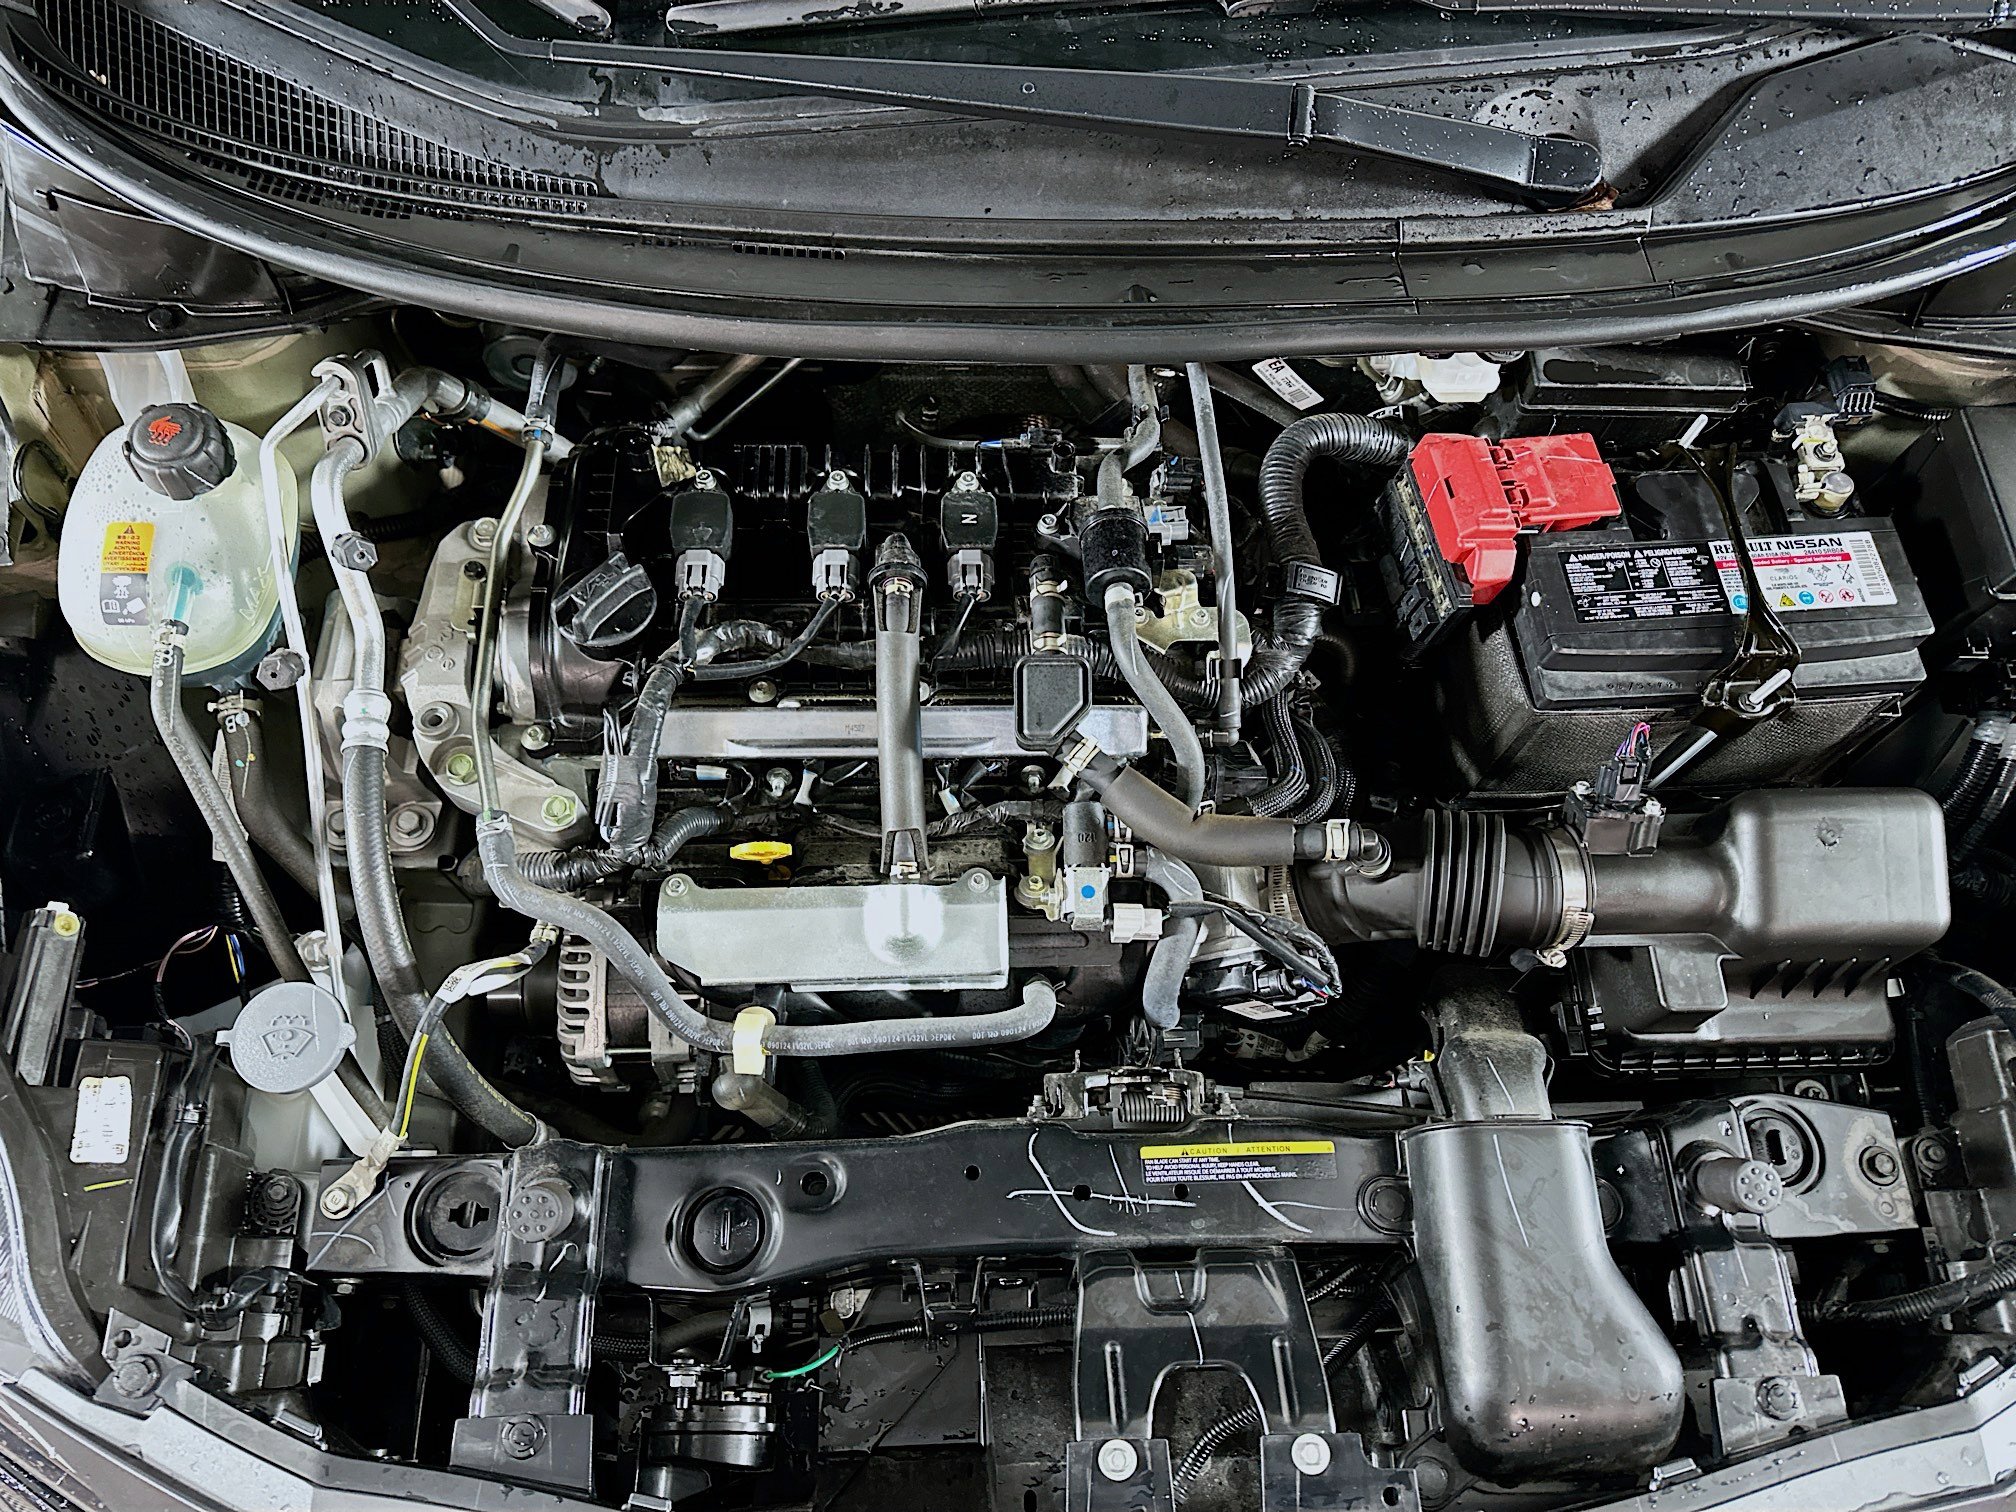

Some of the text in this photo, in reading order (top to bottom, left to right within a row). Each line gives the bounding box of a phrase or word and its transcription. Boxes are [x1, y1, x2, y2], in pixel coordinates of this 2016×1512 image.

[1268, 360, 1285, 373] EA
[1776, 537, 1843, 550] NISSAN
[1190, 1147, 1228, 1155] CAUTION
